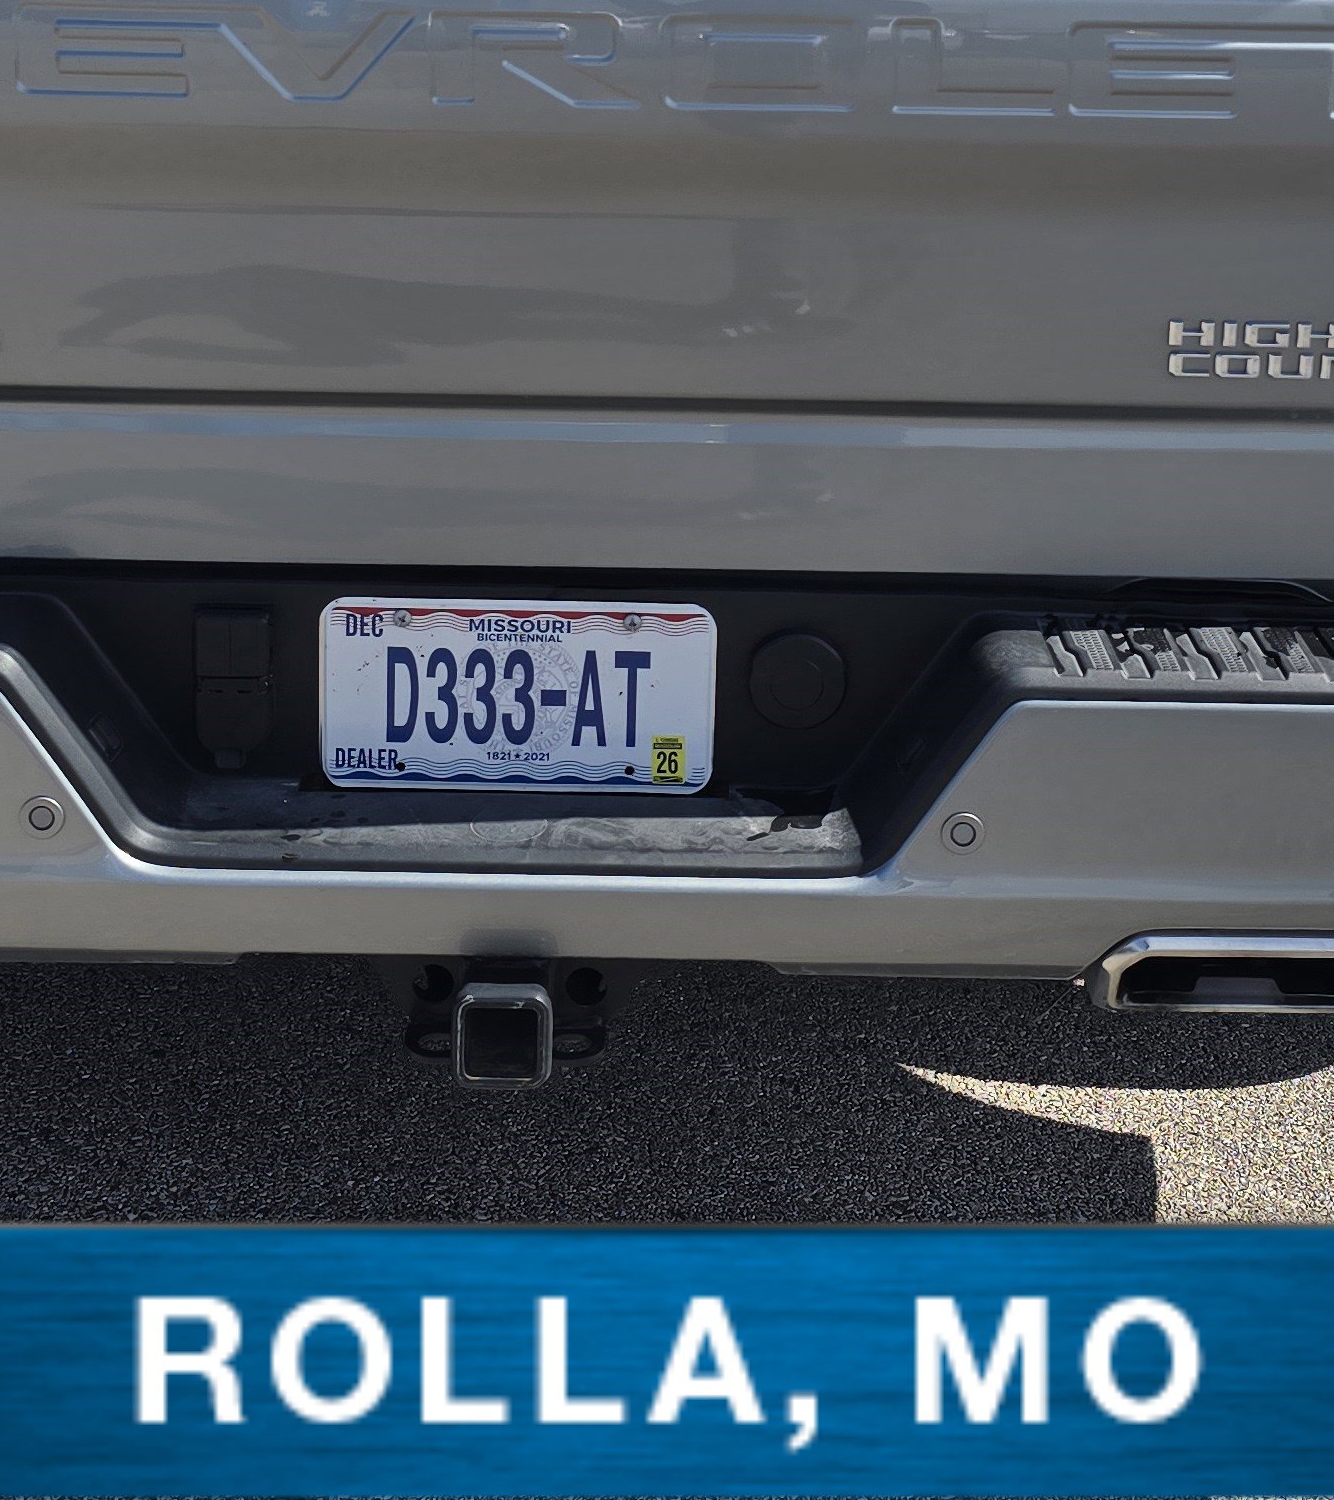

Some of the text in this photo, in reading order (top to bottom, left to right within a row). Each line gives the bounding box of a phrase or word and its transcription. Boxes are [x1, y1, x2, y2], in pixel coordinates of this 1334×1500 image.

[345, 613, 384, 638] DEC
[467, 618, 572, 634] MISSOURI
[476, 632, 563, 643] BICENTENNIAL
[385, 645, 652, 749] D333-AT
[334, 747, 399, 771] DEALER
[656, 750, 679, 775] 26
